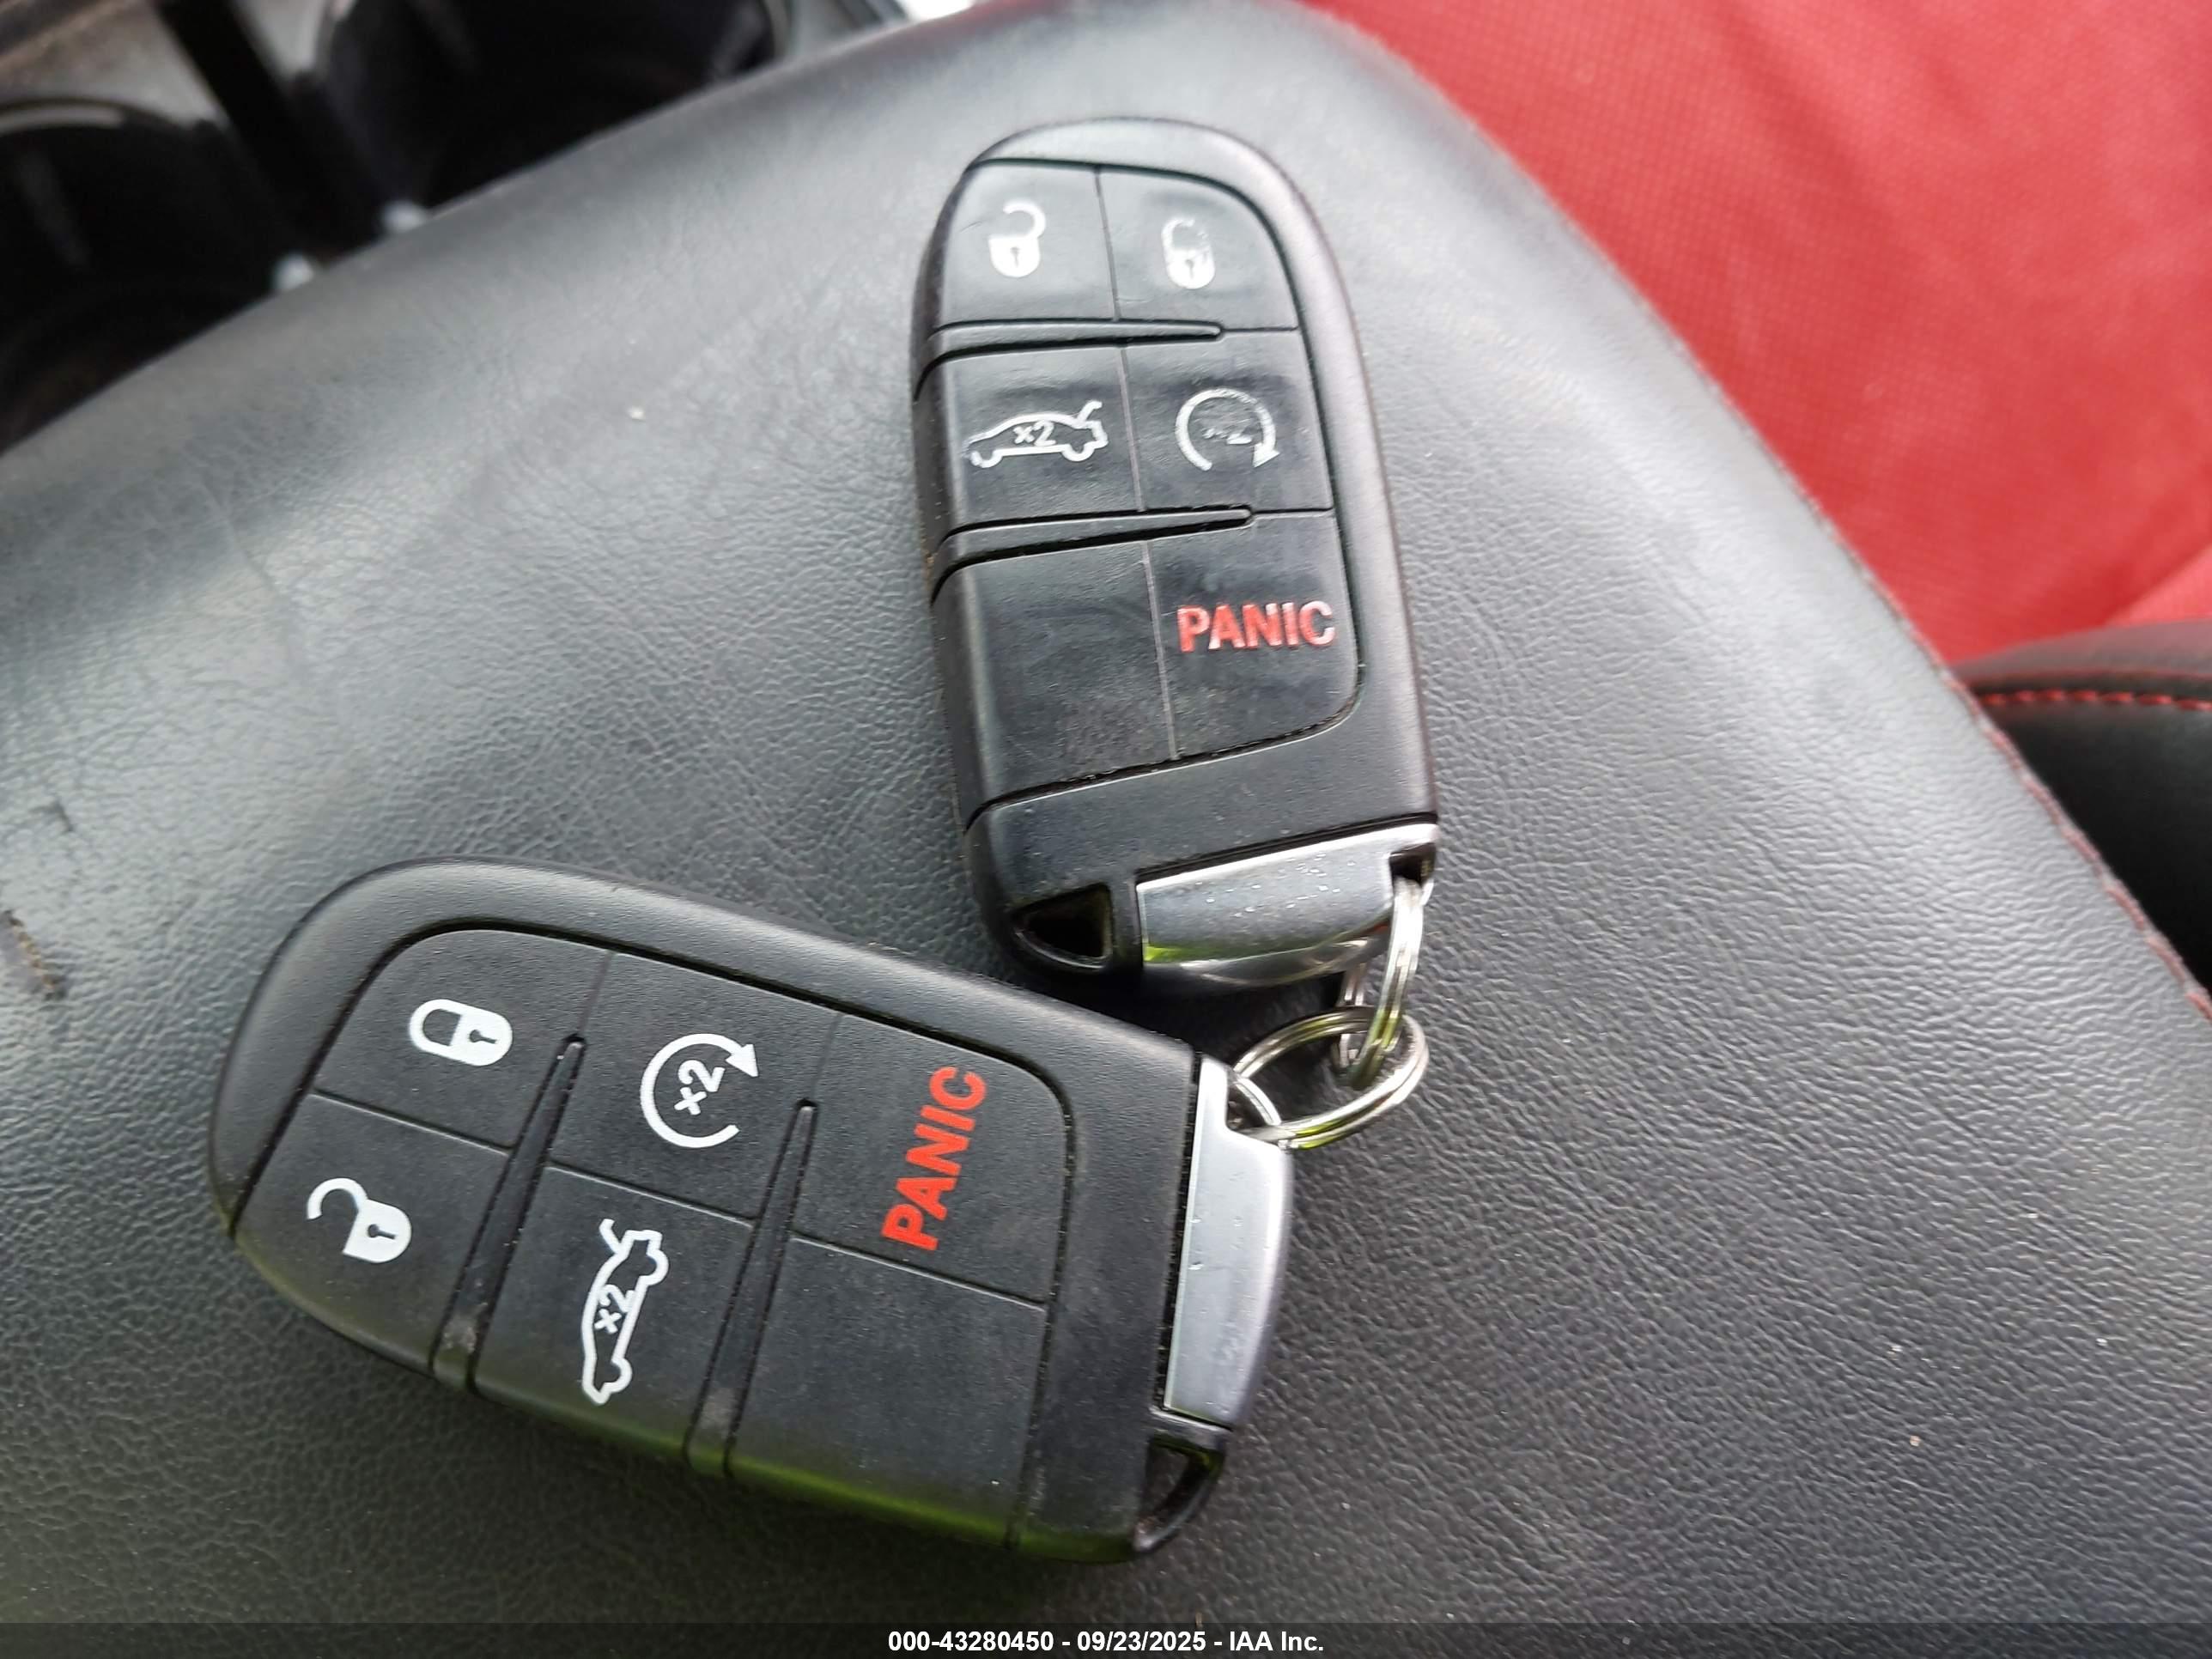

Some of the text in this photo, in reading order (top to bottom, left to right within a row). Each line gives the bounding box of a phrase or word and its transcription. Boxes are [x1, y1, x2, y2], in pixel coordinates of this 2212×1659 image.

[1013, 420, 1057, 447] x2
[1176, 599, 1336, 653] PANIC
[673, 1059, 726, 1116] x2
[880, 1066, 987, 1253] PANIC
[593, 1284, 637, 1334] x2
